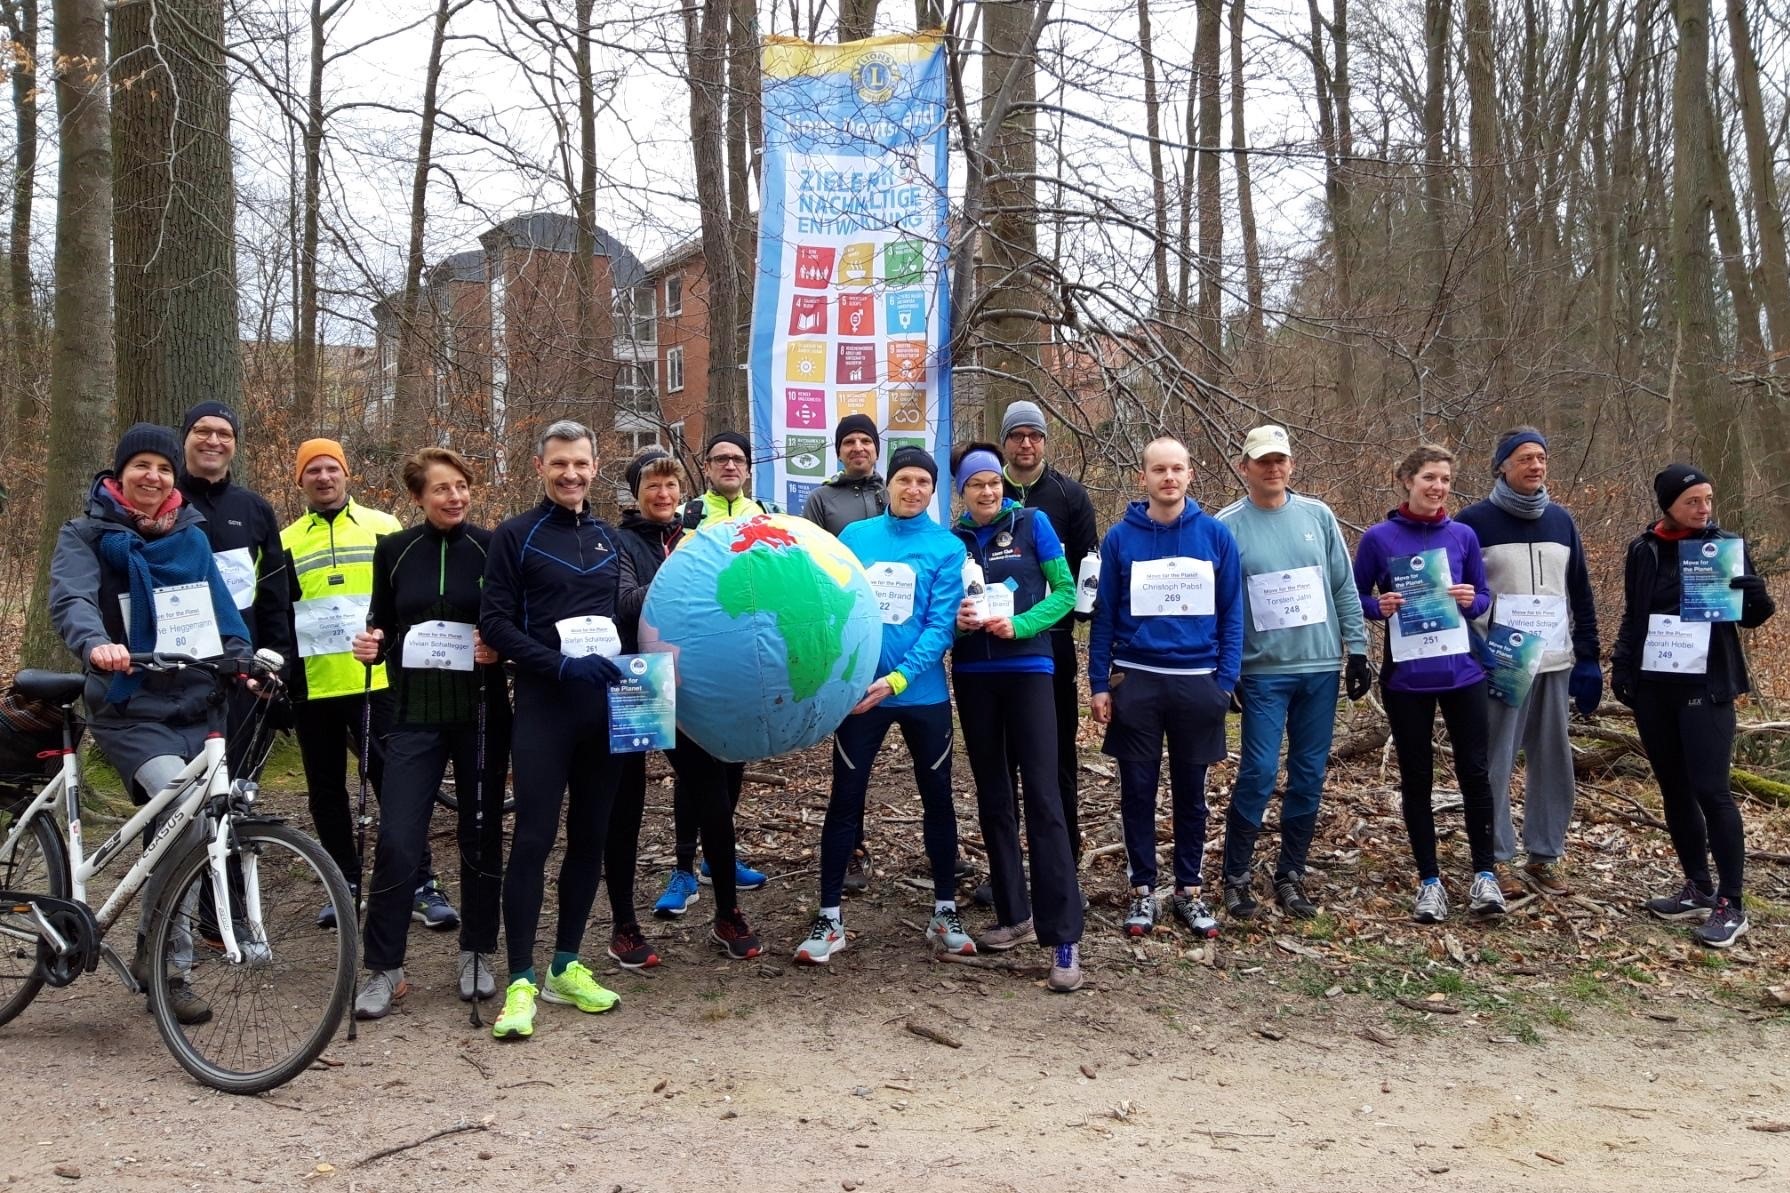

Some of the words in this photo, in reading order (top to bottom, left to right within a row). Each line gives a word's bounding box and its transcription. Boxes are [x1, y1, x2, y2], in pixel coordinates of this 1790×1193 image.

[860, 52, 890, 64] LIONS
[870, 67, 884, 86] L
[843, 102, 934, 138] Deutsand
[800, 169, 862, 192] ZIELE
[799, 187, 922, 214] NACHALTIGE
[797, 208, 922, 236] ENTWKLUNG
[1142, 583, 1179, 591] Christoph
[1405, 579, 1423, 587] Planet
[889, 591, 912, 600] Brand
[1164, 594, 1181, 602] 269
[1266, 596, 1294, 606] Torsten
[1284, 605, 1300, 615] 248
[169, 619, 213, 633] Heggemann
[1507, 618, 1535, 628] Wilfried
[175, 637, 187, 647] 80
[1423, 635, 1439, 645] 251
[1488, 640, 1503, 650] Move
[431, 650, 446, 658] 260
[585, 645, 598, 653] 261
[1496, 649, 1513, 659] Planet
[1658, 650, 1673, 659] 249
[135, 809, 186, 867] PEGASUS
